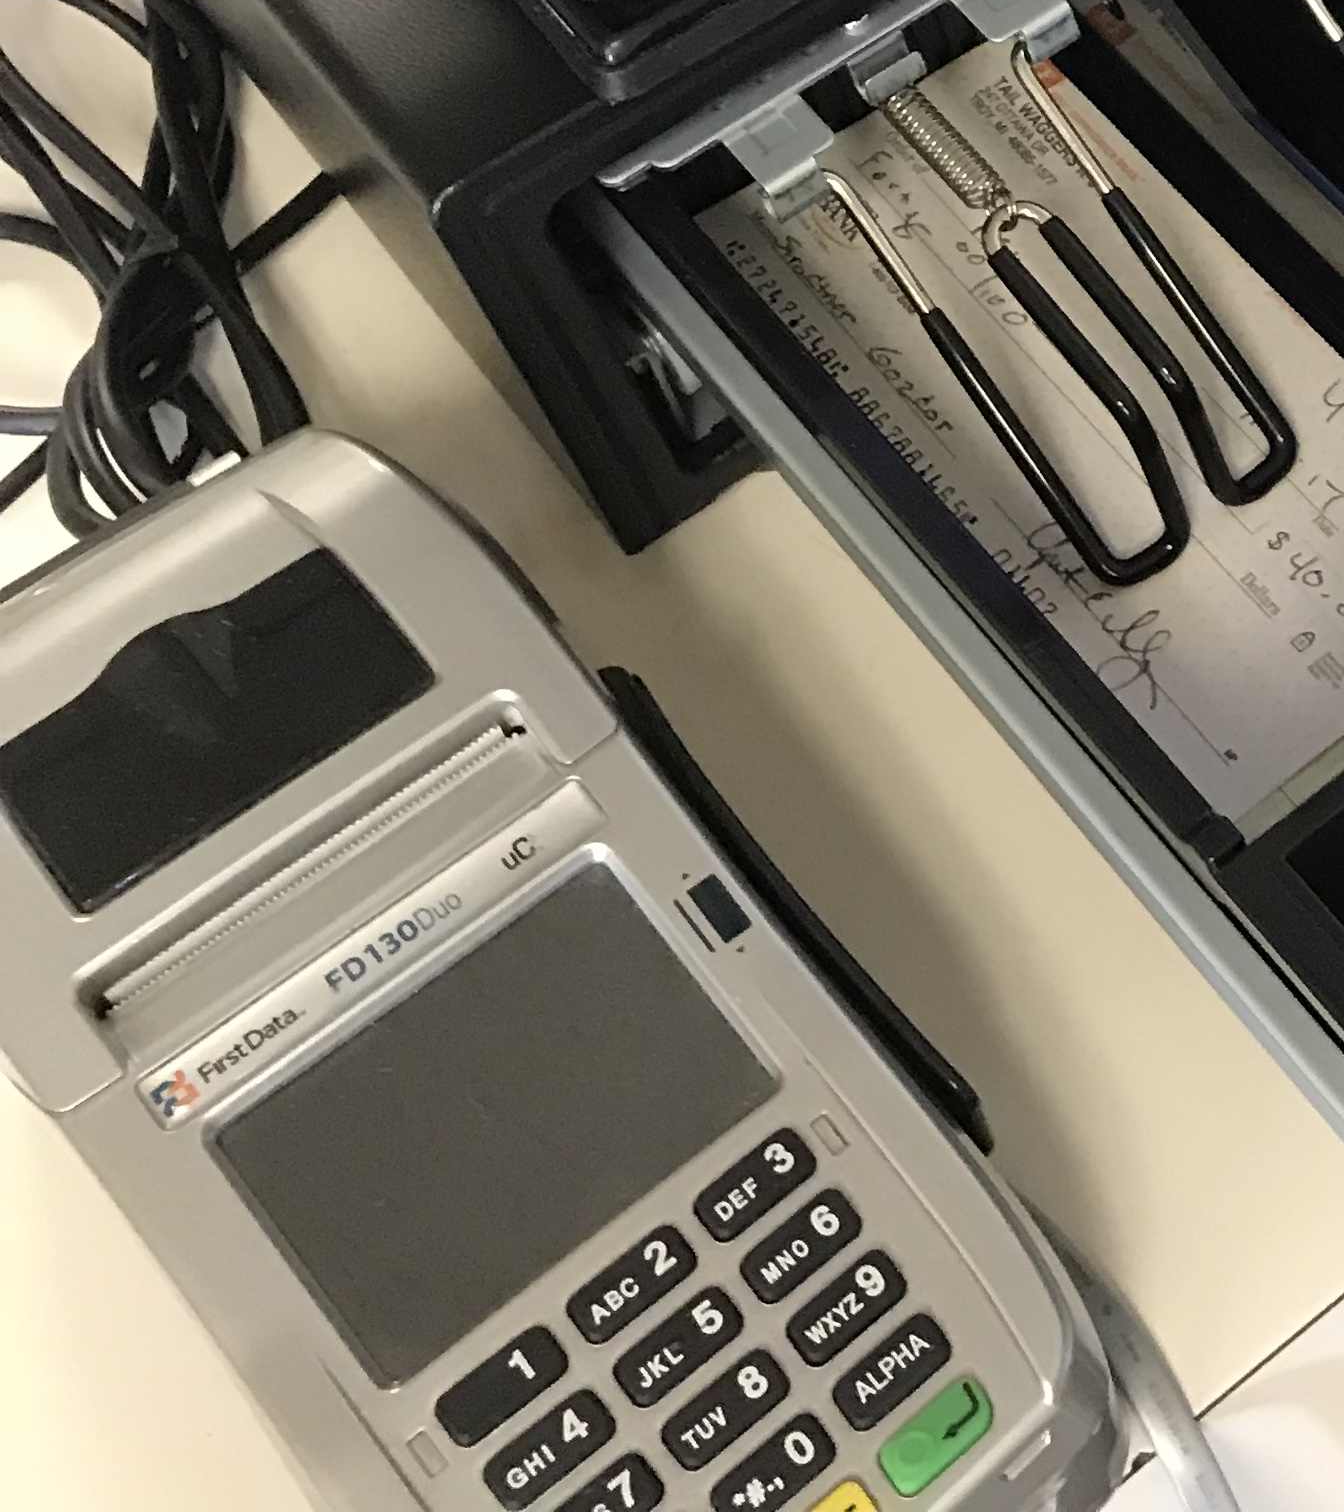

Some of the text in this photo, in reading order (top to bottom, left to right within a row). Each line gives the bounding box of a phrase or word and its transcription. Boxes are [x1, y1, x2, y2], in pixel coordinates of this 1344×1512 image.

[993, 75, 1021, 106] TAIL
[1240, 572, 1281, 617] Dollars
[714, 1142, 795, 1222] DEF 3
[589, 1240, 678, 1325] ABC 2
[760, 1204, 840, 1284] MNO 6
[635, 1299, 724, 1389] JKL 5
[804, 1264, 886, 1345] WXYZ 9
[509, 1348, 536, 1379] 1
[853, 1333, 931, 1405] ALPHA
[681, 1365, 769, 1451] TUV 8
[783, 1431, 814, 1465] 0
[506, 1409, 589, 1489] GHI 4
[607, 1468, 635, 1508] 7
